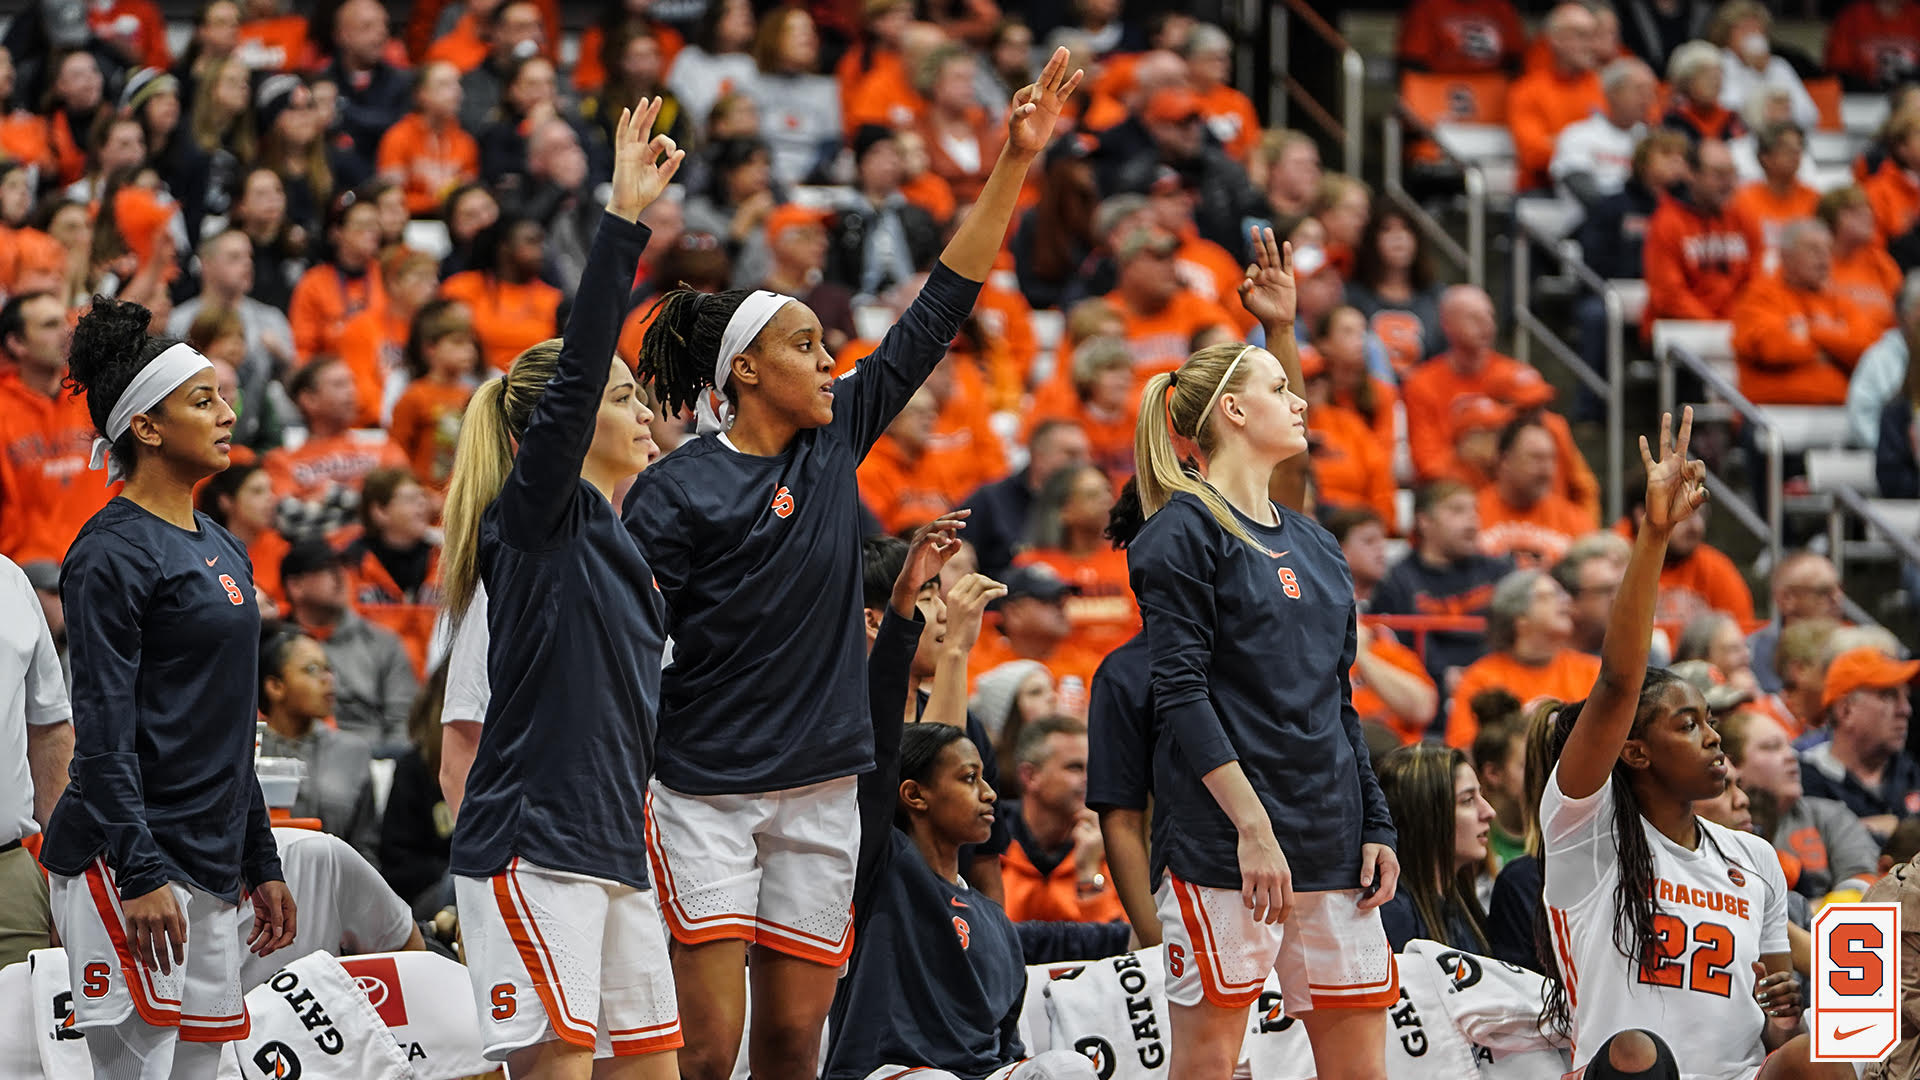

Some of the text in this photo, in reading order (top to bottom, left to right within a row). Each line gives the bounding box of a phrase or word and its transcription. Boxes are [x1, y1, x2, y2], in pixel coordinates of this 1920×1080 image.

[772, 486, 795, 519] S
[219, 573, 244, 606] S
[1278, 567, 1301, 600] S
[952, 916, 971, 950] S
[1168, 942, 1186, 980] S
[1637, 912, 1736, 999] 22
[82, 960, 111, 999] S
[265, 968, 345, 1056] GATO
[489, 981, 519, 1022] S
